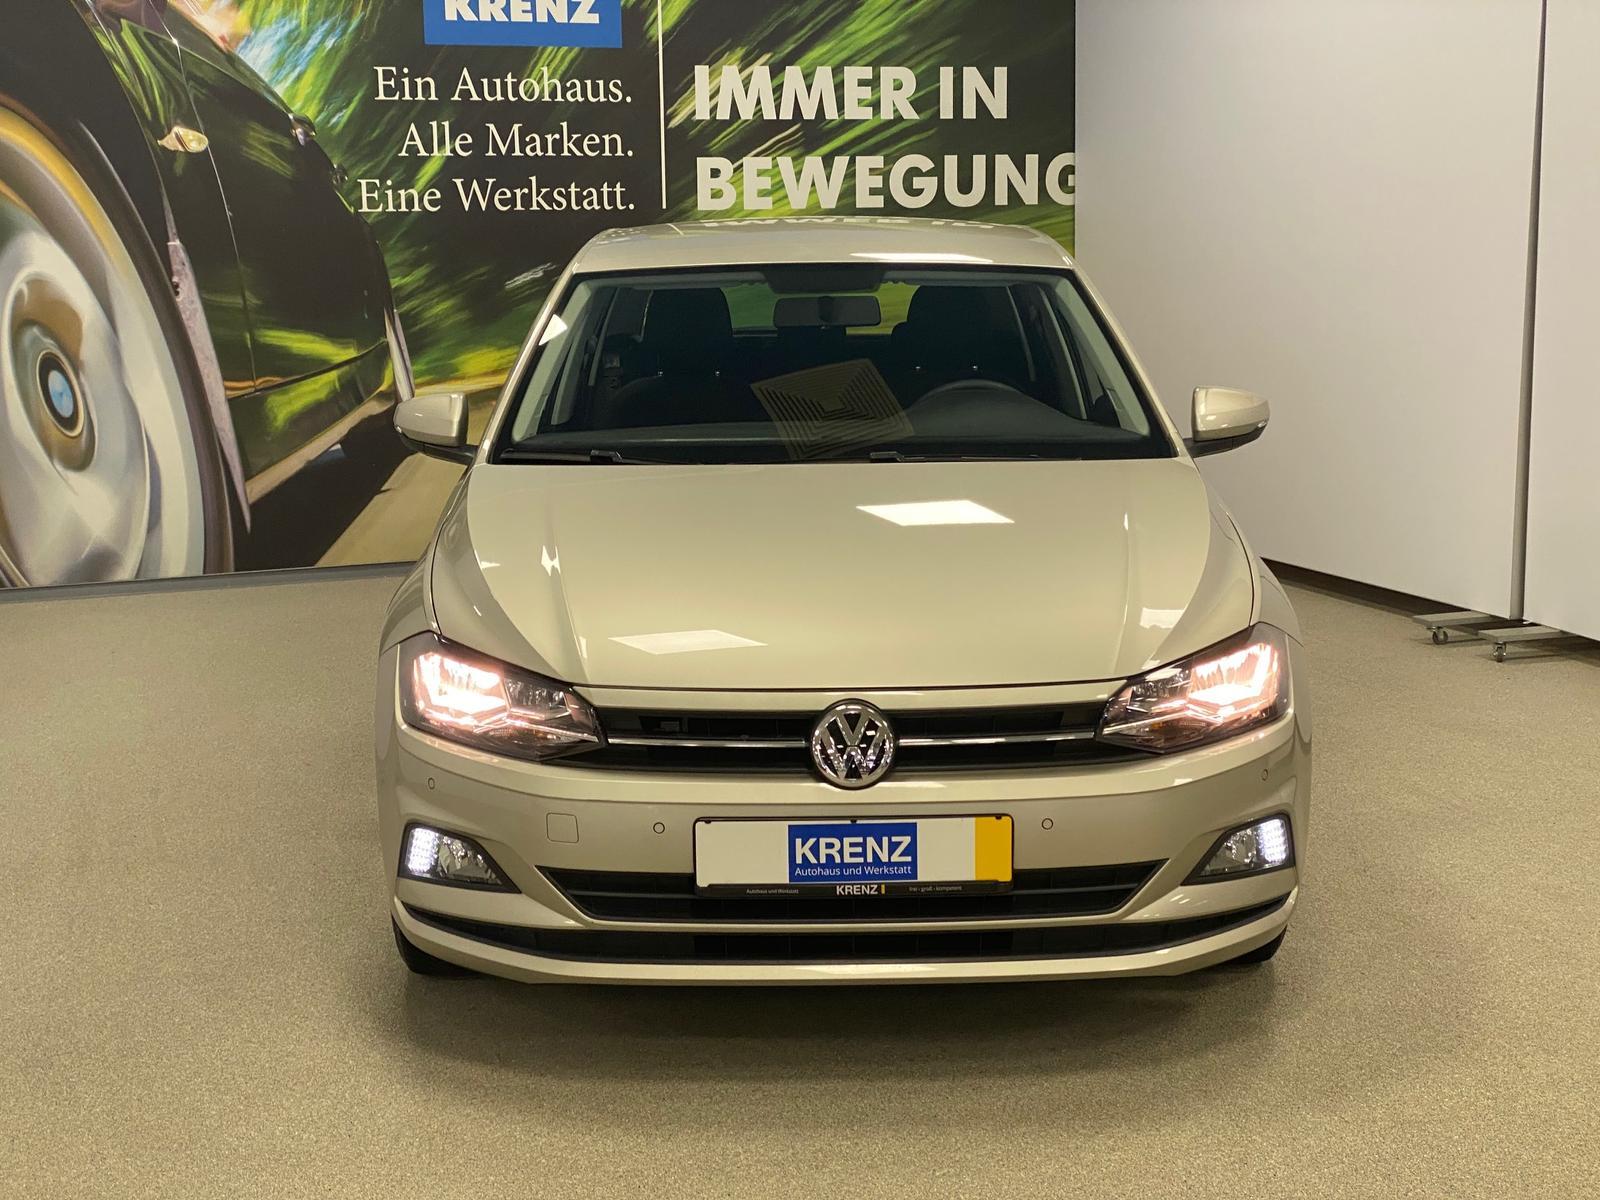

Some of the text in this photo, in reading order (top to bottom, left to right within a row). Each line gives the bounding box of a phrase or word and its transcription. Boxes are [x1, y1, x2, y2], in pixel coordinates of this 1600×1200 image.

[444, 0, 600, 24] KRENZ
[373, 66, 632, 103] Ein Autohaus.
[694, 64, 1008, 120] IMMER IN
[398, 121, 633, 157] Alle Marken.
[357, 175, 635, 213] Eine Werkstatt.
[696, 153, 1076, 211] BEWEGUNG
[795, 836, 912, 864] KRENZ
[794, 865, 912, 876] Autohaus und Werkstatt
[836, 885, 878, 895] KRENZ
